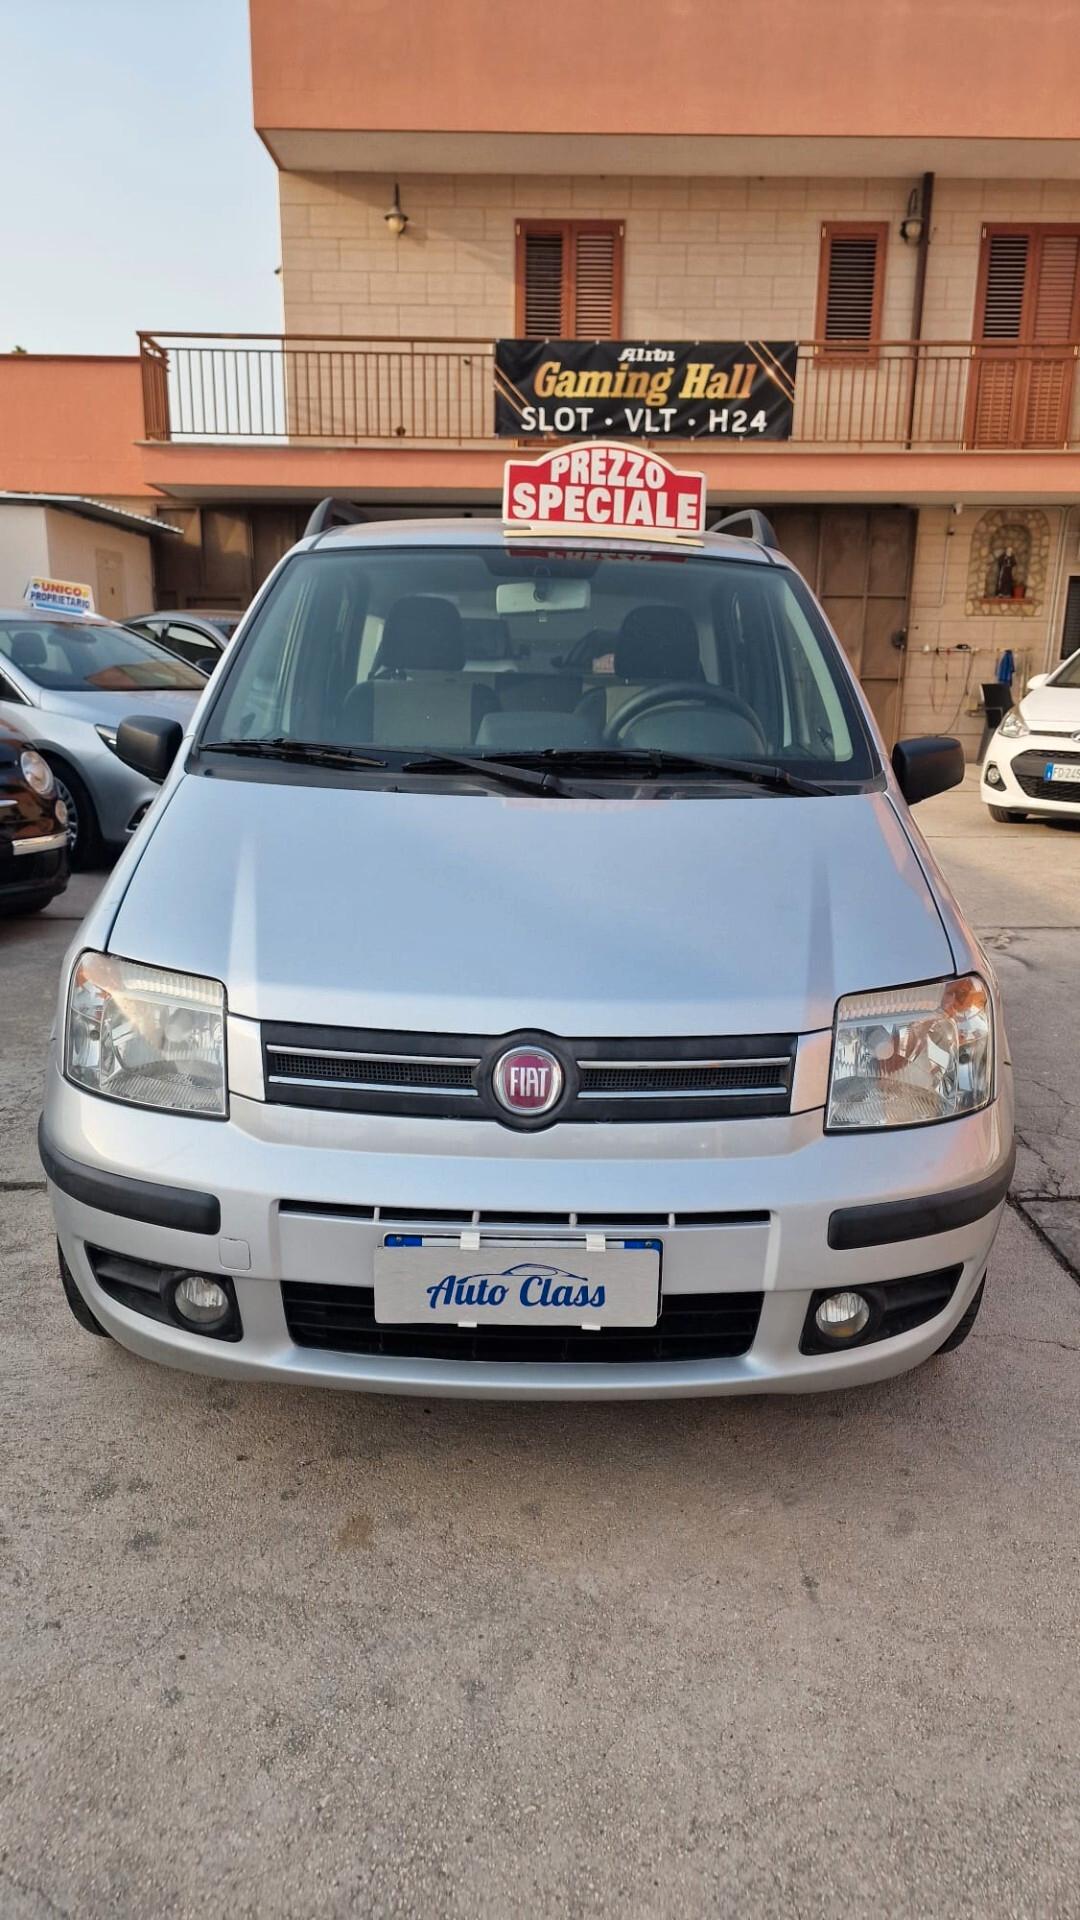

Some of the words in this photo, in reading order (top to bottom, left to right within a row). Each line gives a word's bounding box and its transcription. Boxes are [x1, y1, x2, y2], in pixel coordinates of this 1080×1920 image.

[533, 361, 676, 408] Gaming
[678, 362, 758, 399] Hall
[520, 406, 594, 432] SLOT
[624, 408, 678, 433] VLT
[708, 408, 768, 433] H24
[550, 448, 666, 490] PREZZO
[512, 482, 699, 529] SPECIALE
[30, 591, 90, 609] PROPRIETARIO
[41, 582, 82, 597] UNICO
[510, 1066, 550, 1097] FIAT
[426, 1275, 509, 1309] Auto
[519, 1276, 606, 1308] Class
